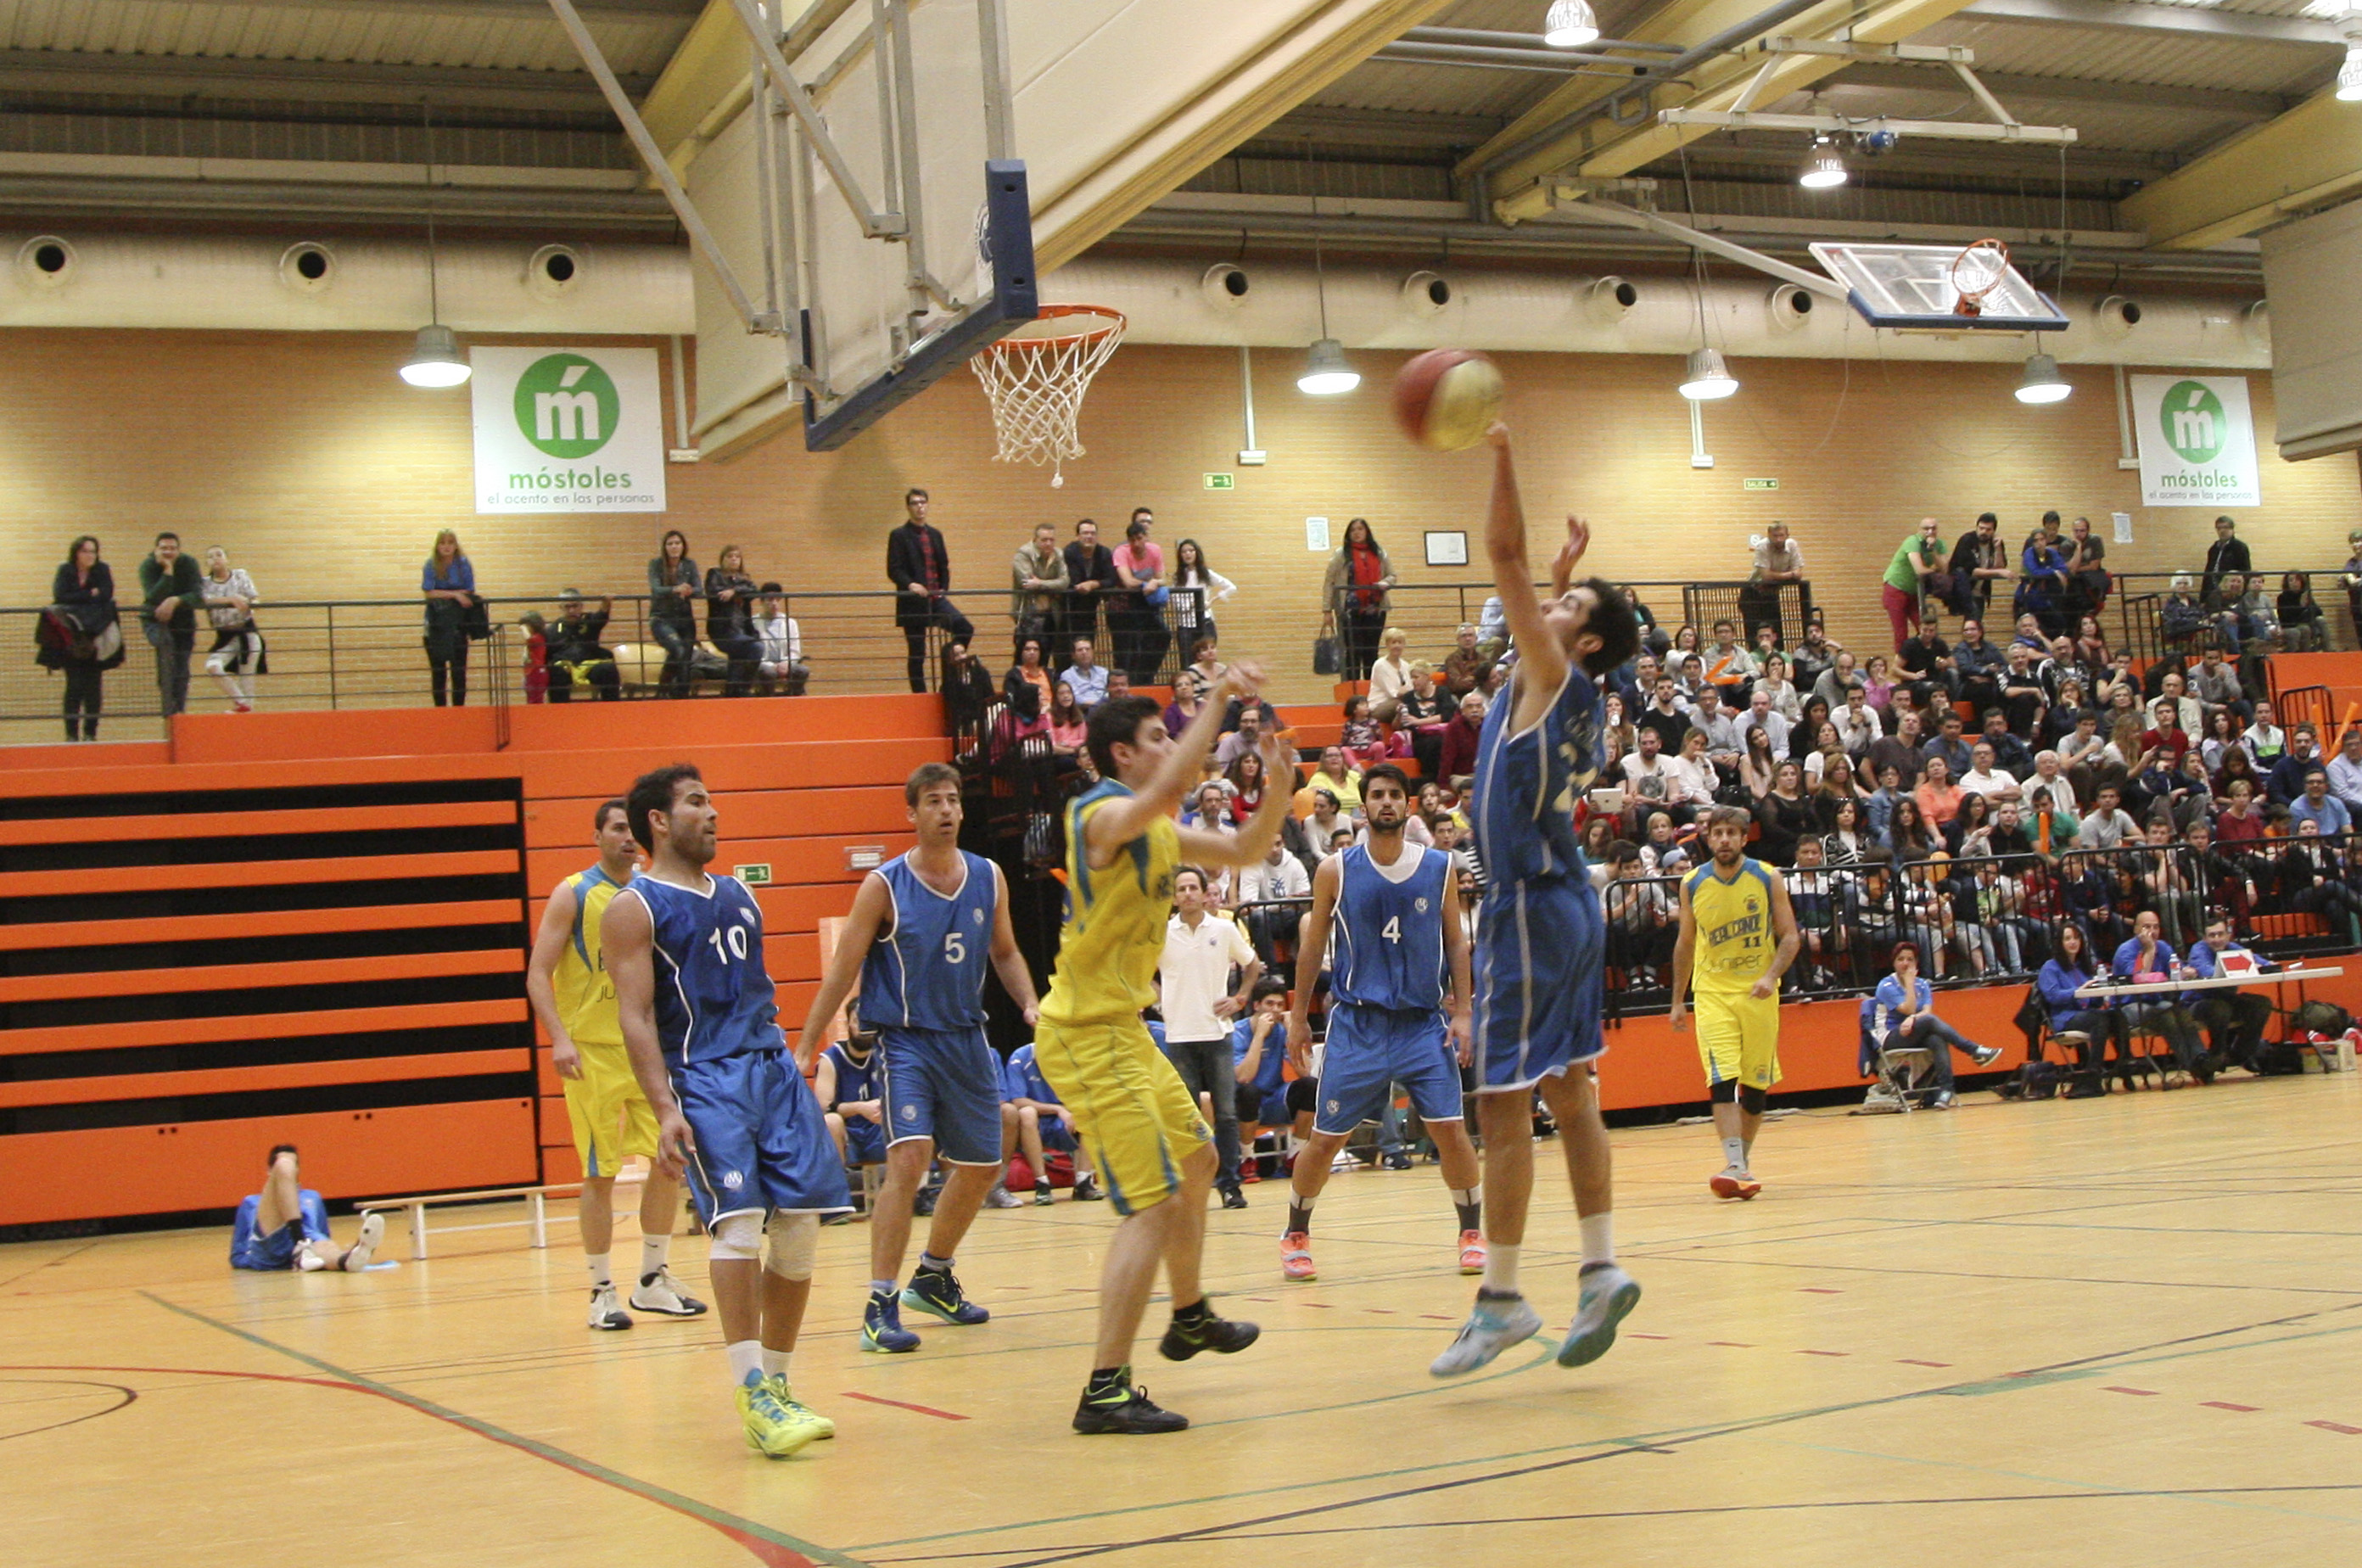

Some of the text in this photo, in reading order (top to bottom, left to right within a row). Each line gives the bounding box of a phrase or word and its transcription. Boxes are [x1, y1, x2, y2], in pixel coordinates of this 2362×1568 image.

[509, 466, 632, 490] móstoles
[2161, 469, 2238, 487] móstoles
[487, 492, 655, 507] el acento en las personas
[1381, 915, 1402, 945] 4
[1743, 935, 1762, 949] 11
[708, 924, 747, 965] 10
[944, 932, 966, 965] 5
